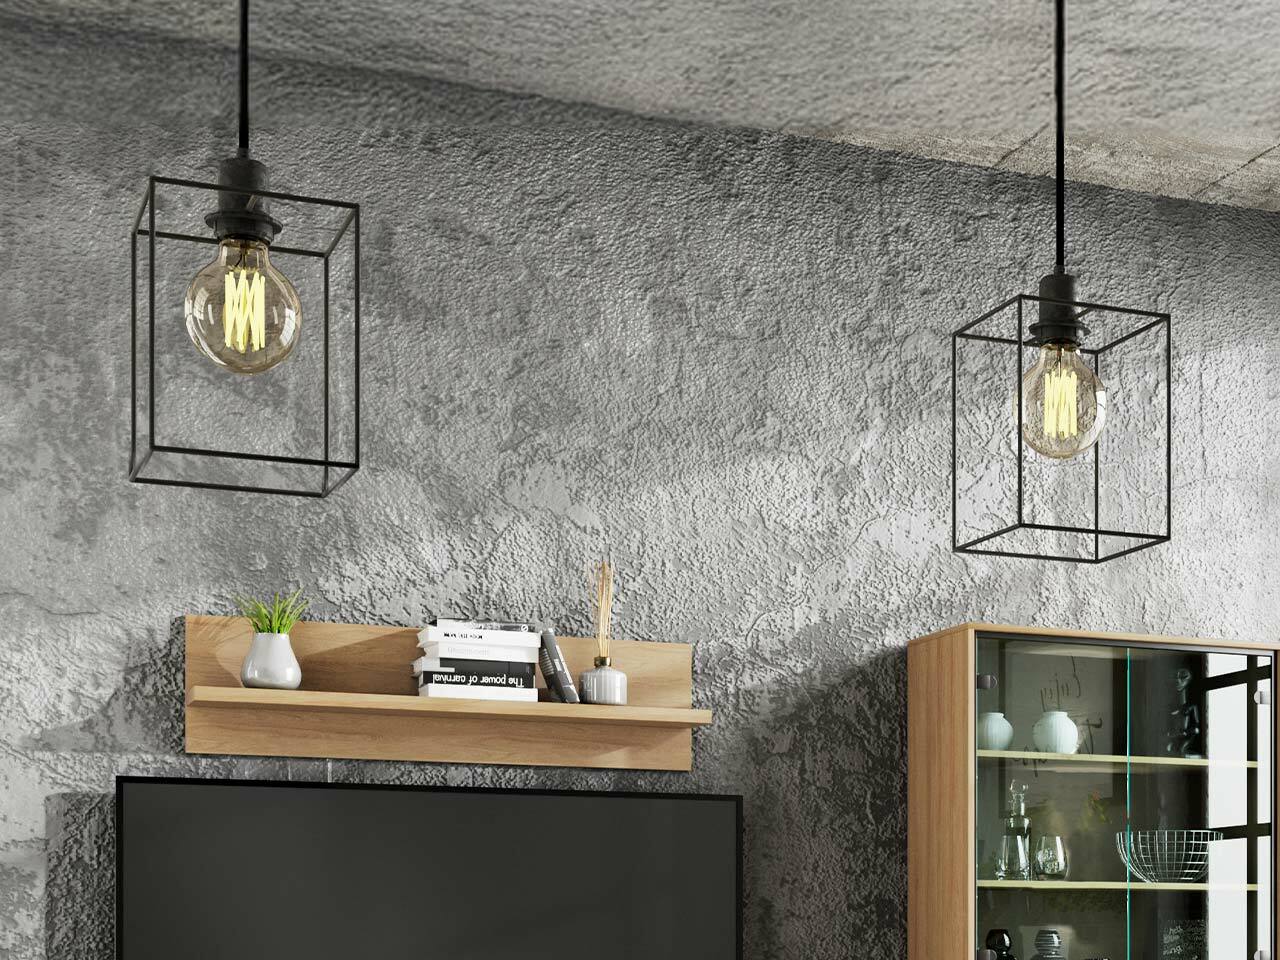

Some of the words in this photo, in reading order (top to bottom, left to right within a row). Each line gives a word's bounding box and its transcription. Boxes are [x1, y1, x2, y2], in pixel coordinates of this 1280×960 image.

[432, 673, 466, 685] carnival
[467, 675, 479, 686] of
[480, 673, 507, 685] power
[508, 677, 525, 688] The
